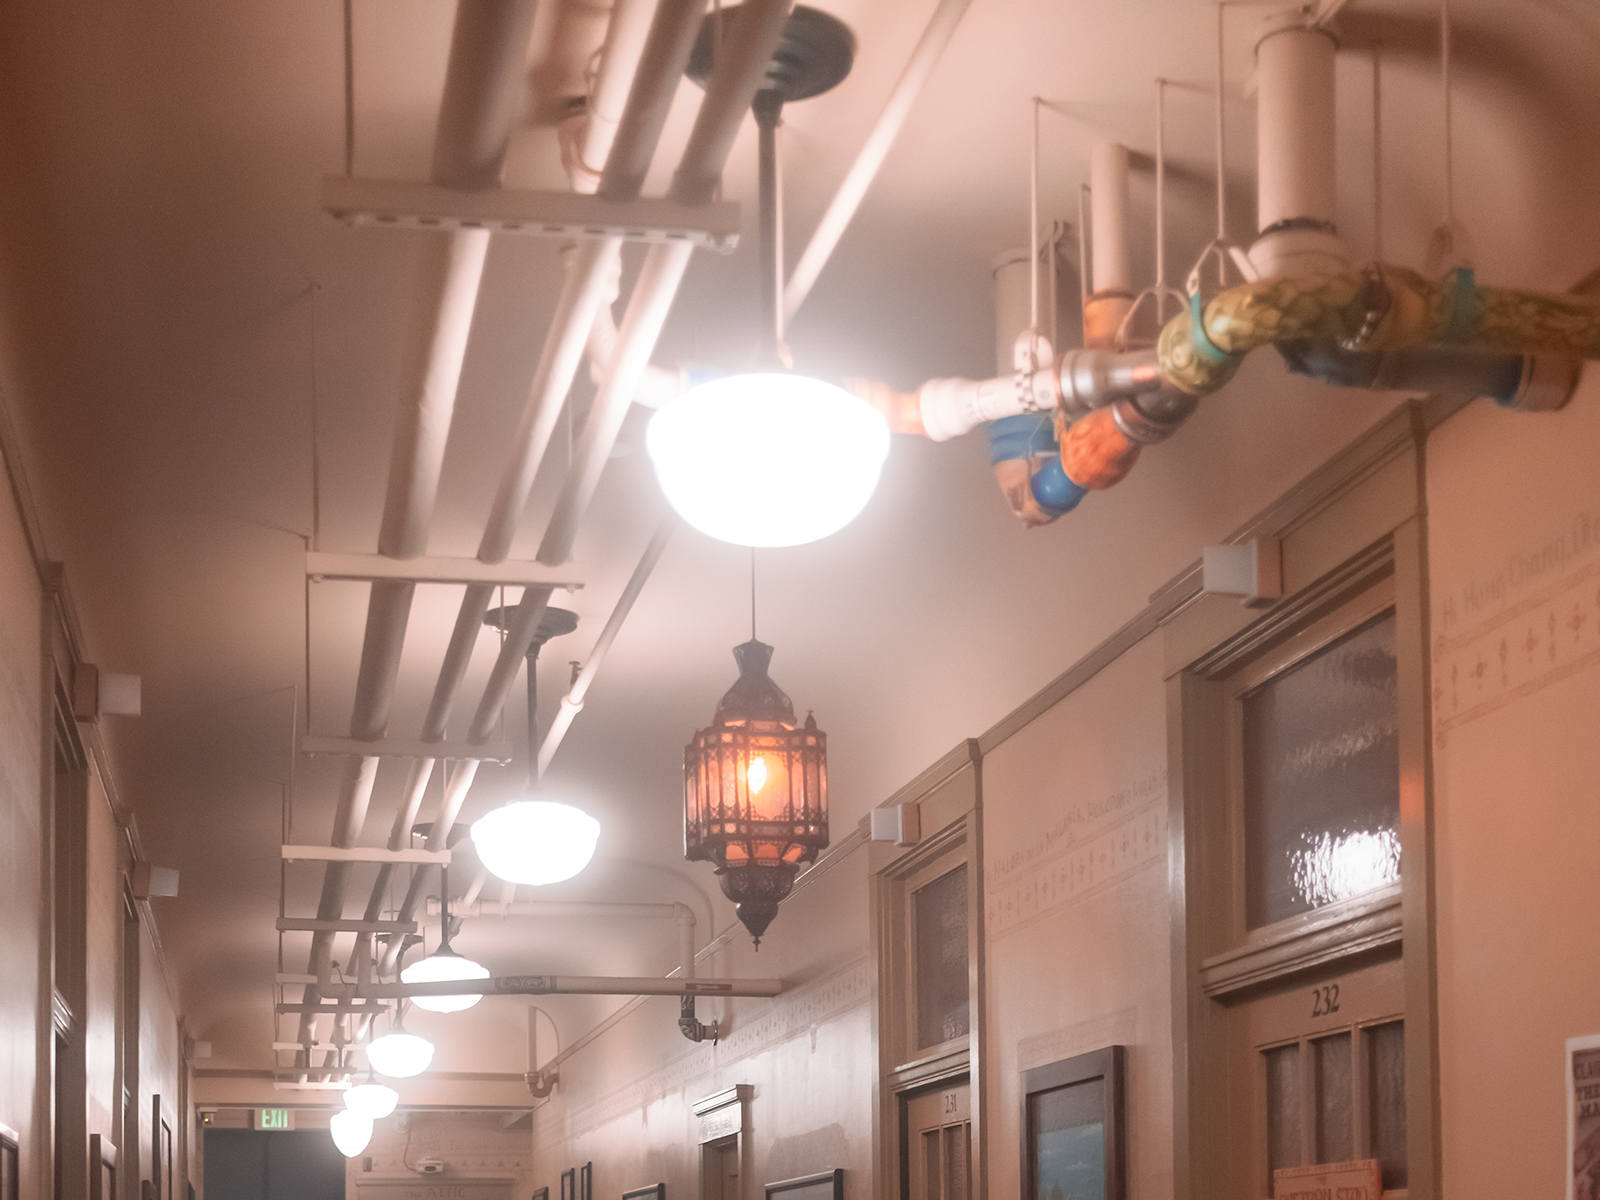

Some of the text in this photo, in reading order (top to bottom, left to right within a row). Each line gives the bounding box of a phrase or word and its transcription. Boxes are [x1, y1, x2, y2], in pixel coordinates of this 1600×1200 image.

[1311, 984, 1340, 1018] 232
[945, 1094, 957, 1114] 231
[262, 1109, 288, 1128] EXIT
[428, 1188, 466, 1198] ATTIC
